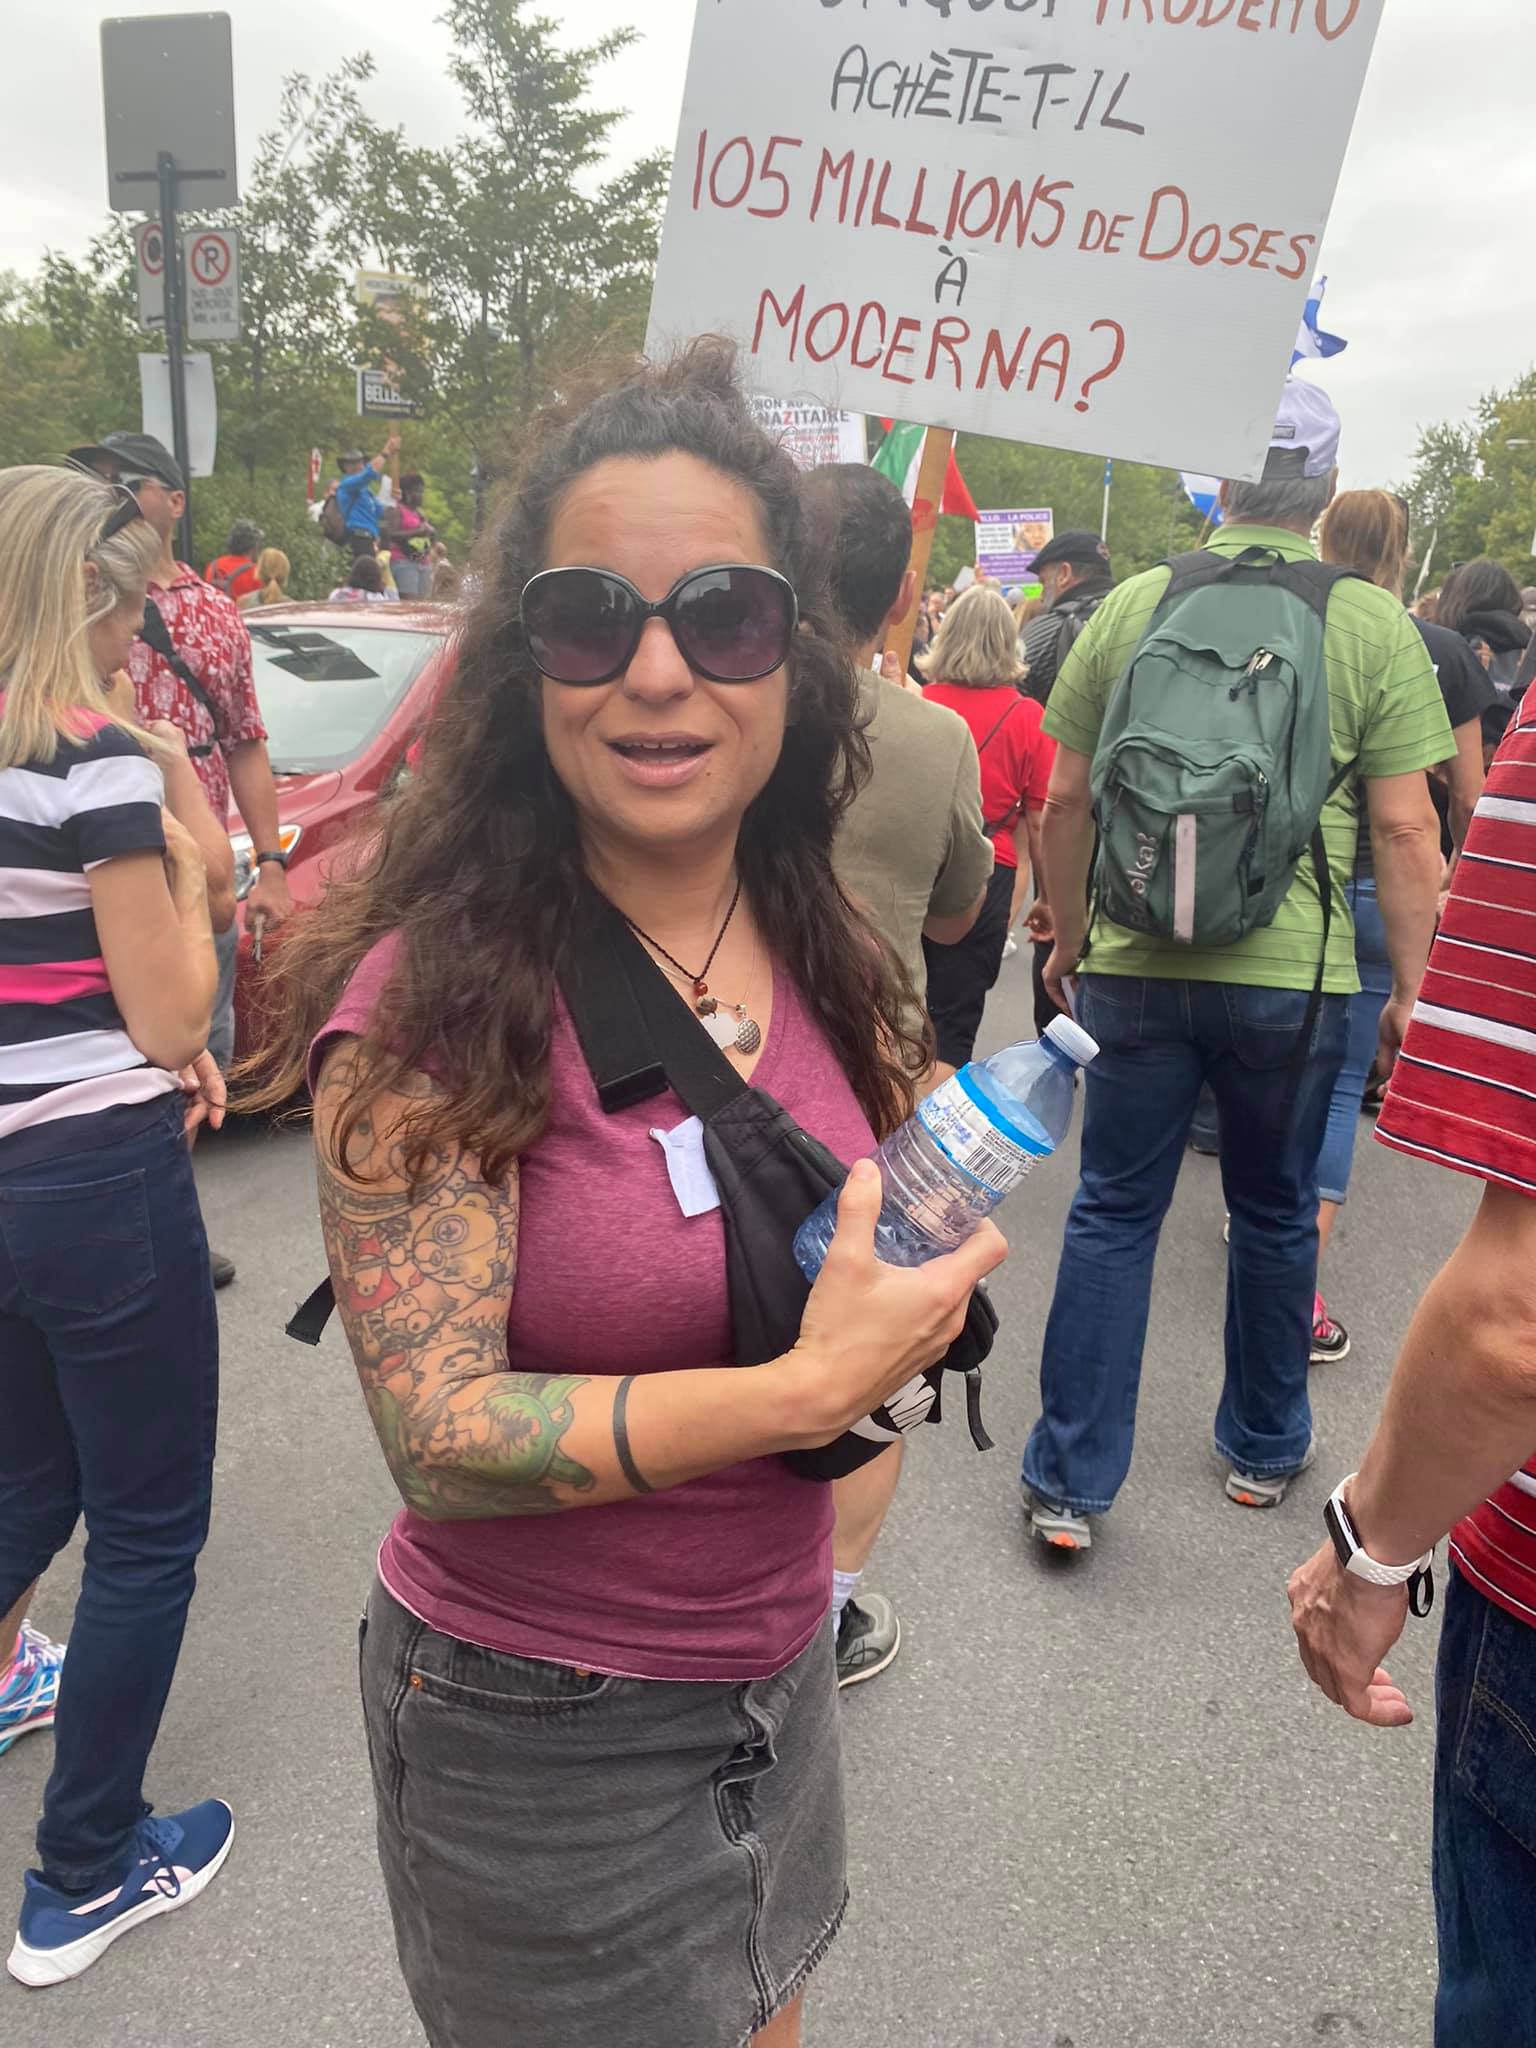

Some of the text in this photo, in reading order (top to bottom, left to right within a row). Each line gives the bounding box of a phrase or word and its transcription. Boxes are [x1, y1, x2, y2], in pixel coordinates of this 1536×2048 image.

[830, 44, 1145, 135] ACHÈTE-T-IL
[692, 129, 1316, 280] 105 MILLIONS DE DOSES
[934, 244, 968, 306] À
[752, 284, 1125, 412] MODERNA?
